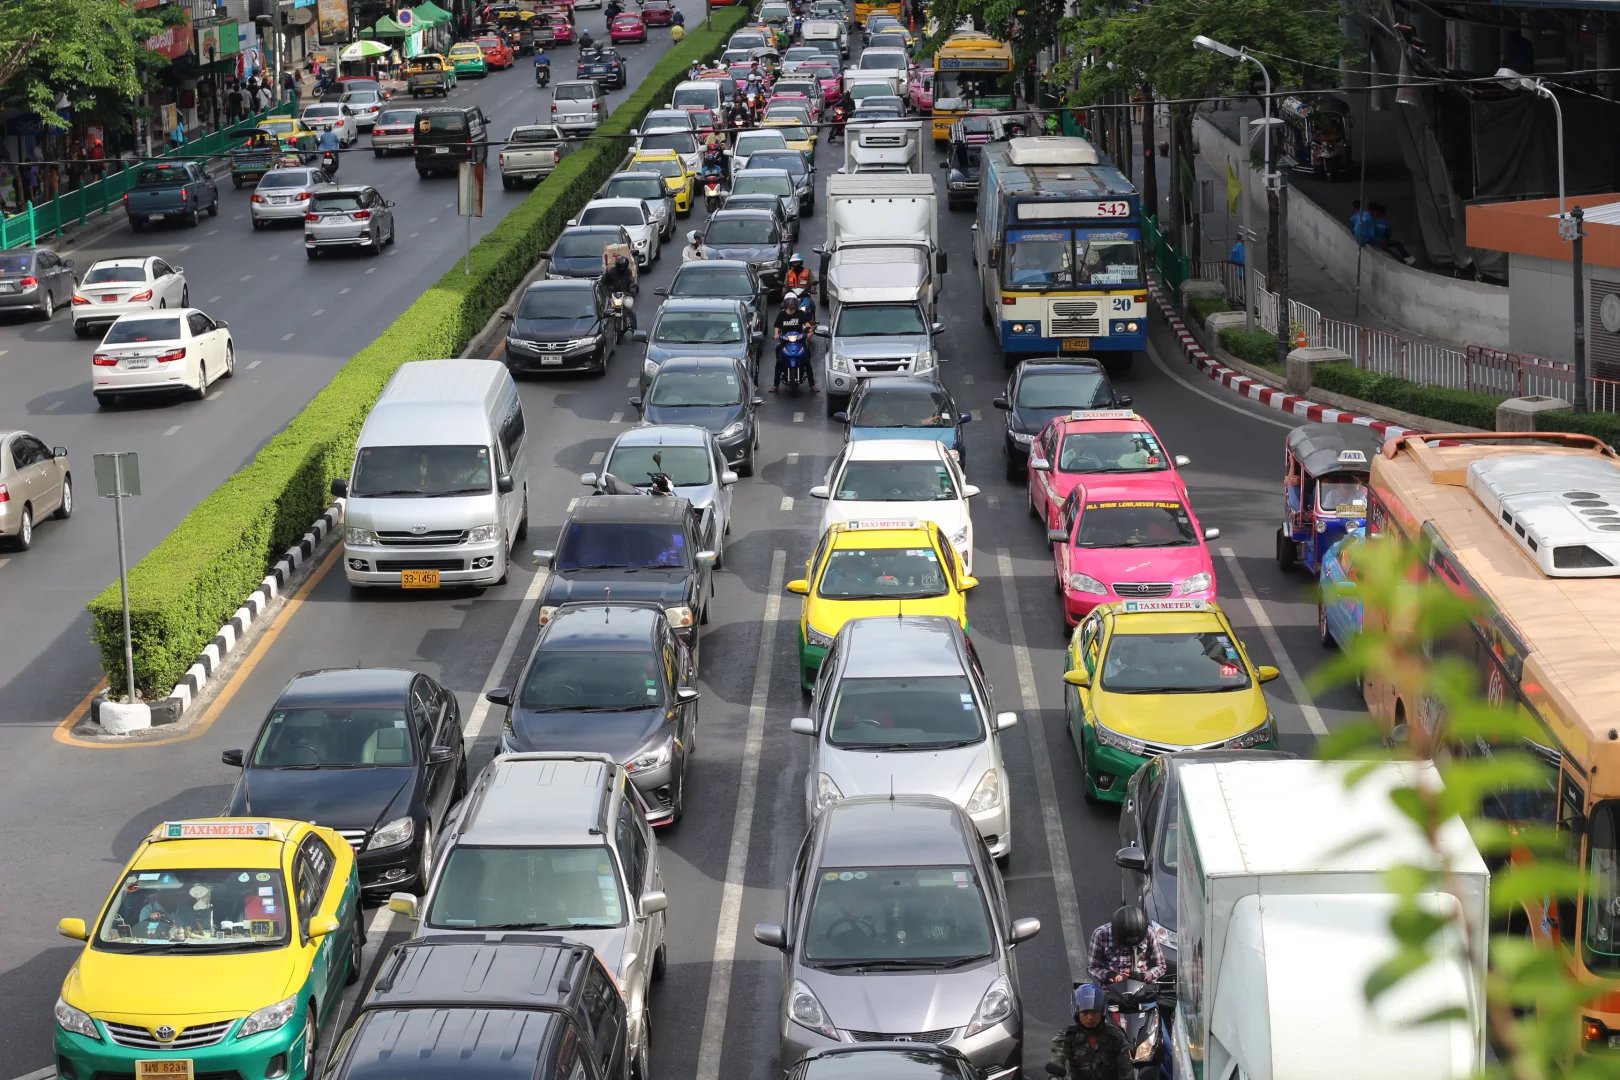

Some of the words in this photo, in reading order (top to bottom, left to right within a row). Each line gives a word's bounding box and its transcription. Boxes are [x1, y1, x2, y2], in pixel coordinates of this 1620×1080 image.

[1097, 203, 1127, 216] 542
[1113, 298, 1131, 311] 20
[404, 574, 437, 583] 33-1450
[183, 825, 255, 835] TAXI-METER
